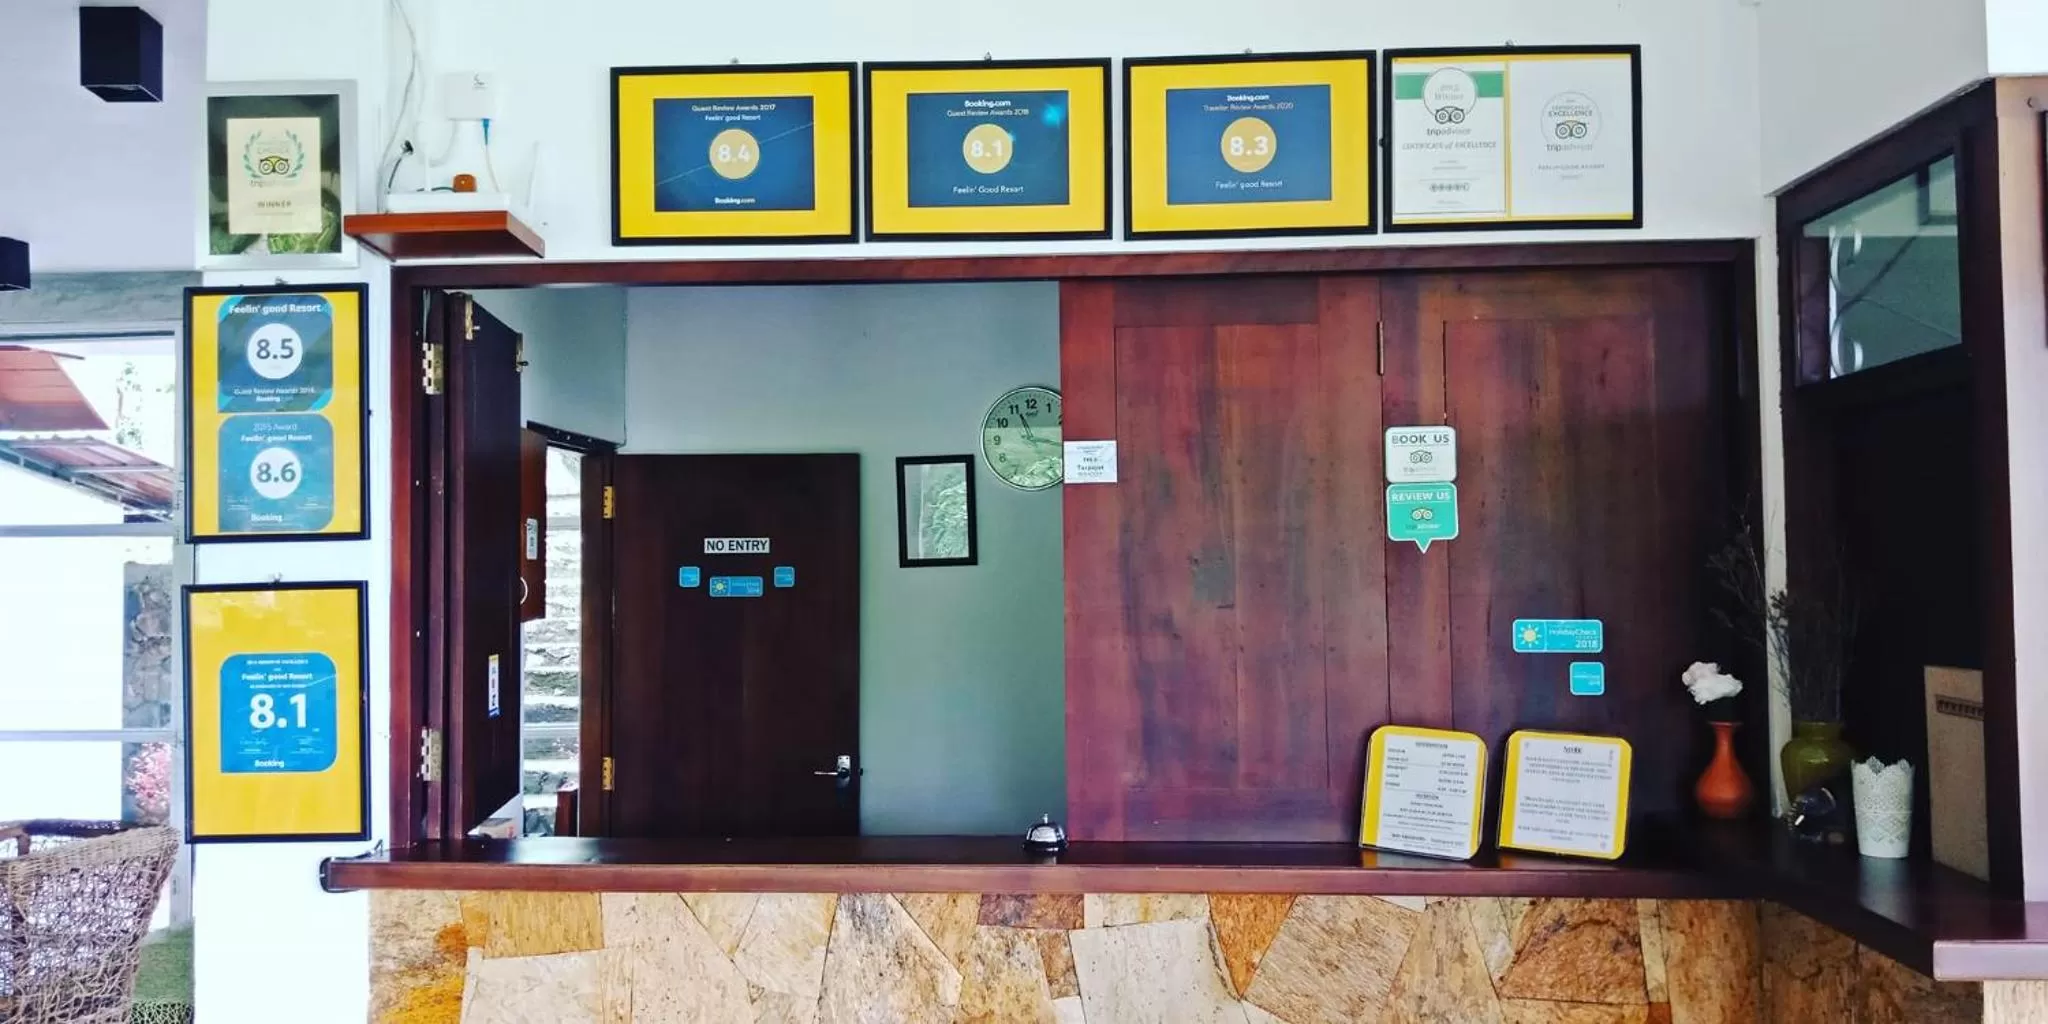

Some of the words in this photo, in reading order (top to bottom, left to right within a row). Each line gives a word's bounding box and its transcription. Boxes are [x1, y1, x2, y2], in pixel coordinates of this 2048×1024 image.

[1227, 94, 1270, 102] Booking.com
[964, 99, 1012, 108] Booking.com
[1276, 102, 1294, 110] 2020
[725, 114, 741, 122] good
[971, 140, 1004, 158] 8.1
[1230, 135, 1269, 157] 8.3
[717, 143, 752, 163] 8.4
[953, 185, 978, 195] Feelin'
[978, 184, 1000, 194] Good
[1000, 184, 1024, 193] Resort
[1240, 180, 1259, 191] good
[1260, 179, 1283, 188] Resort
[257, 201, 292, 209] WINNER
[714, 197, 756, 205] Booking.com
[229, 304, 261, 314] Feelin'
[262, 303, 288, 315] good
[289, 303, 322, 313] Resort
[256, 338, 295, 360] 8.5
[1025, 399, 1037, 409] 12
[1046, 403, 1051, 413] 1
[1009, 405, 1019, 414] 11
[997, 418, 1009, 428] 10
[993, 435, 1001, 445] 9
[1392, 435, 1427, 444] BOOK
[1433, 434, 1450, 444] US
[998, 453, 1006, 463] 8
[256, 462, 296, 483] 8.6
[1391, 492, 1433, 501] REVIEW
[1437, 491, 1450, 500] US
[706, 540, 725, 551] NO
[728, 540, 768, 551] ENTRY
[1576, 640, 1599, 648] 2018
[268, 673, 288, 682] good
[288, 672, 313, 680] Resort
[249, 693, 306, 729] 8.1
